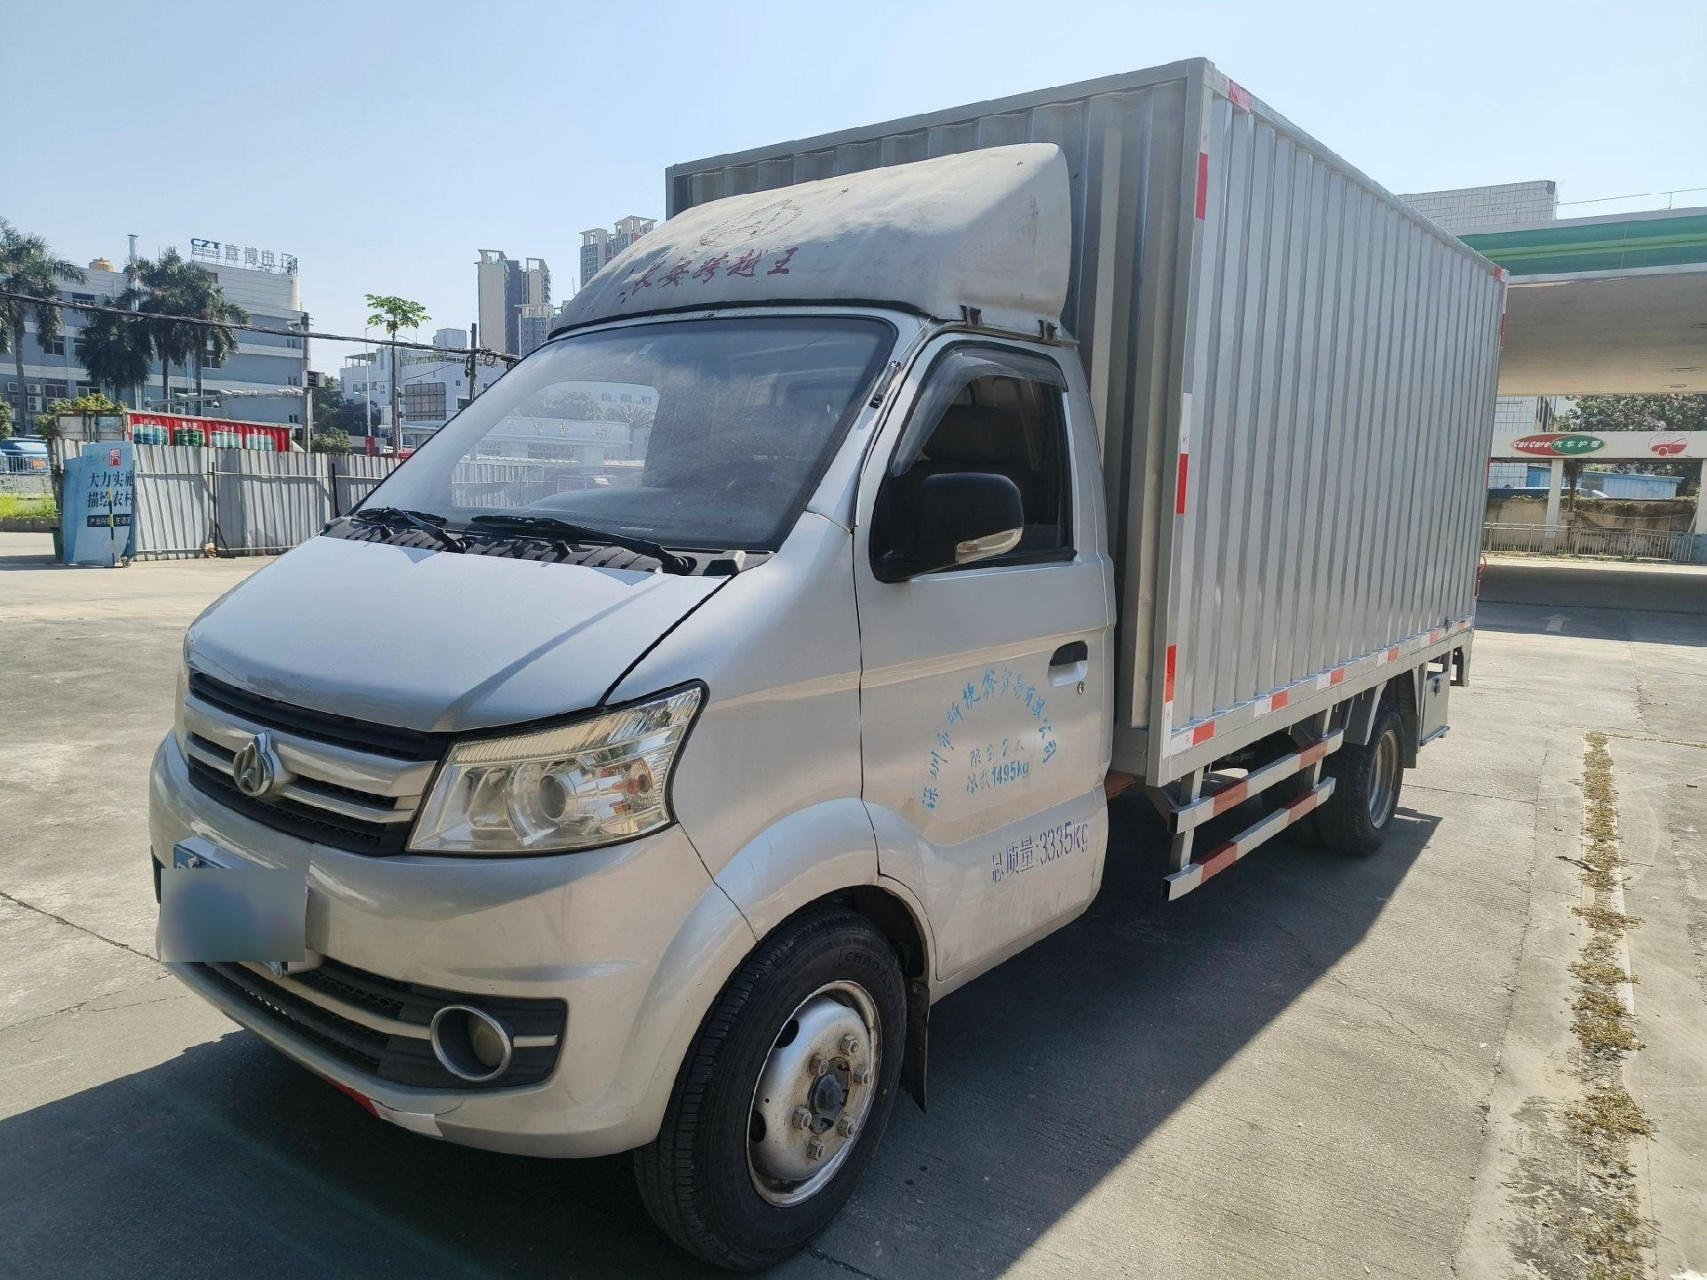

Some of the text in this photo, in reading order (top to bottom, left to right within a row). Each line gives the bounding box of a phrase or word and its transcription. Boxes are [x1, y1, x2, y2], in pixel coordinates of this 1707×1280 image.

[190, 238, 221, 250] CZT
[89, 471, 133, 488] 大力实施
